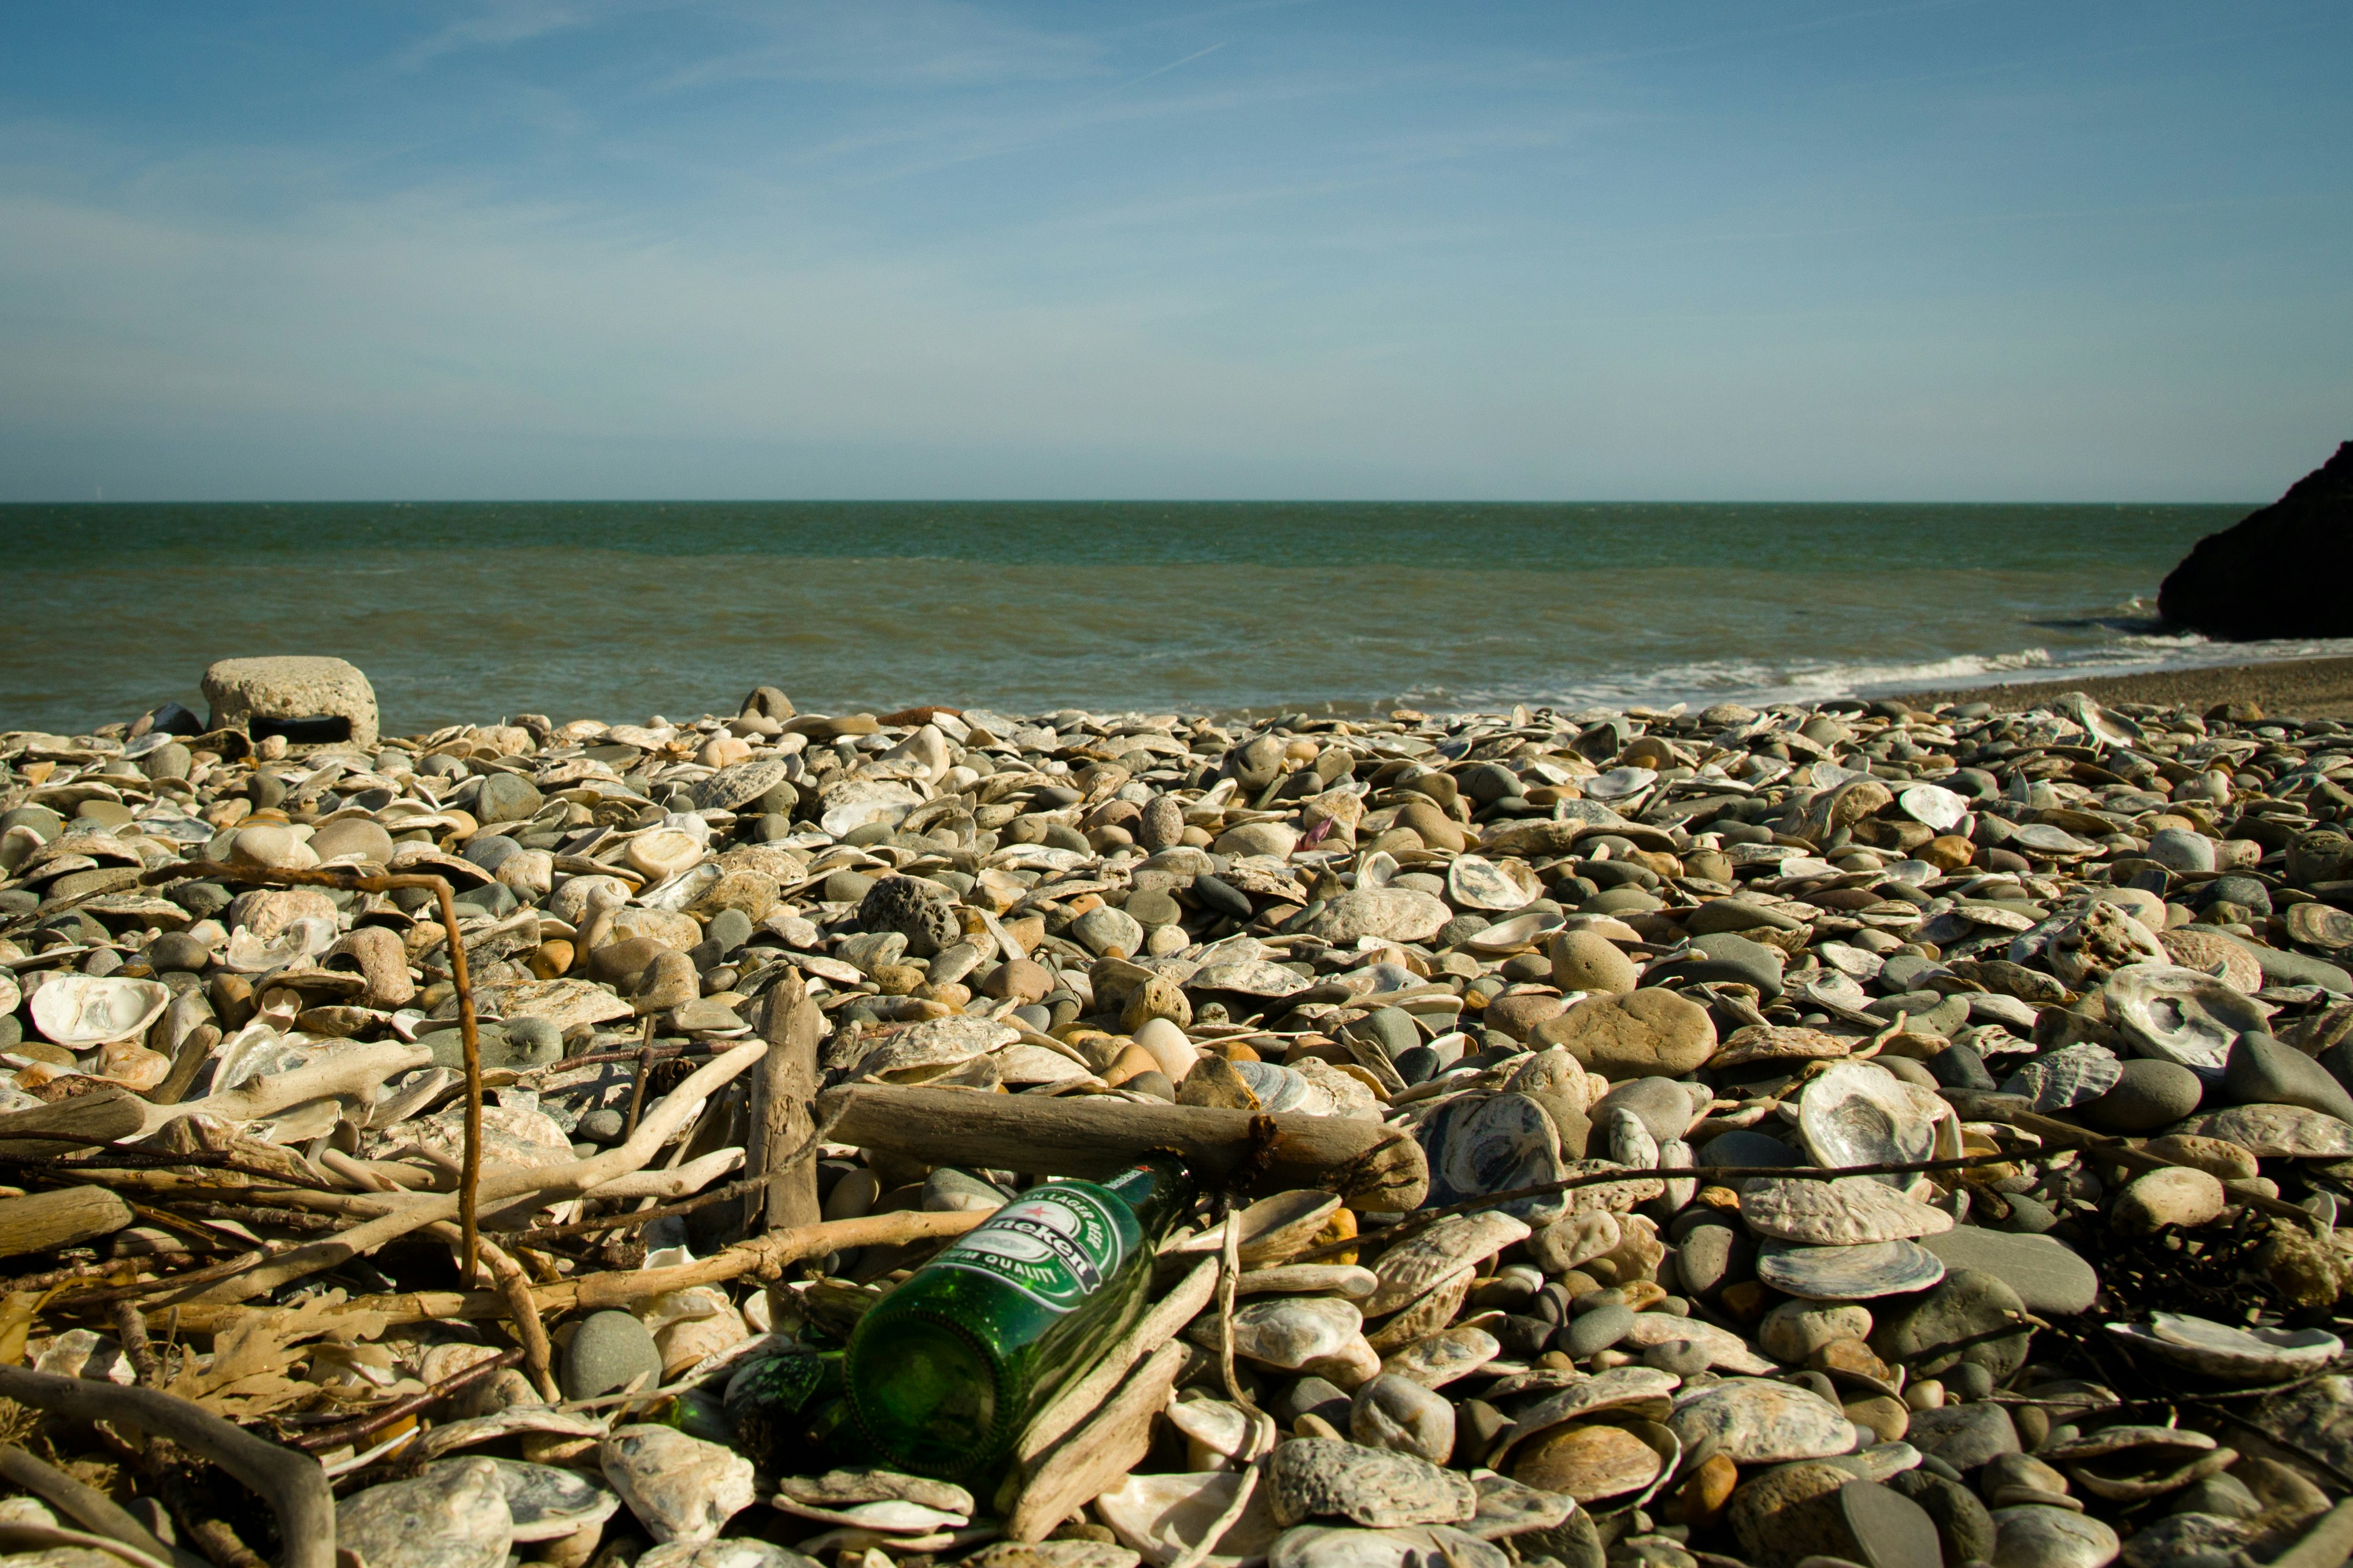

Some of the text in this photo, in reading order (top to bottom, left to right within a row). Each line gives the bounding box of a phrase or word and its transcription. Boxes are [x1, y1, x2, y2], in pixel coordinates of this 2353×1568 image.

[981, 1219, 1090, 1277] ineken
[1048, 1193, 1095, 1218] LAGER
[1085, 1219, 1104, 1250] BEER
[984, 1254, 1058, 1283] QUALITY
